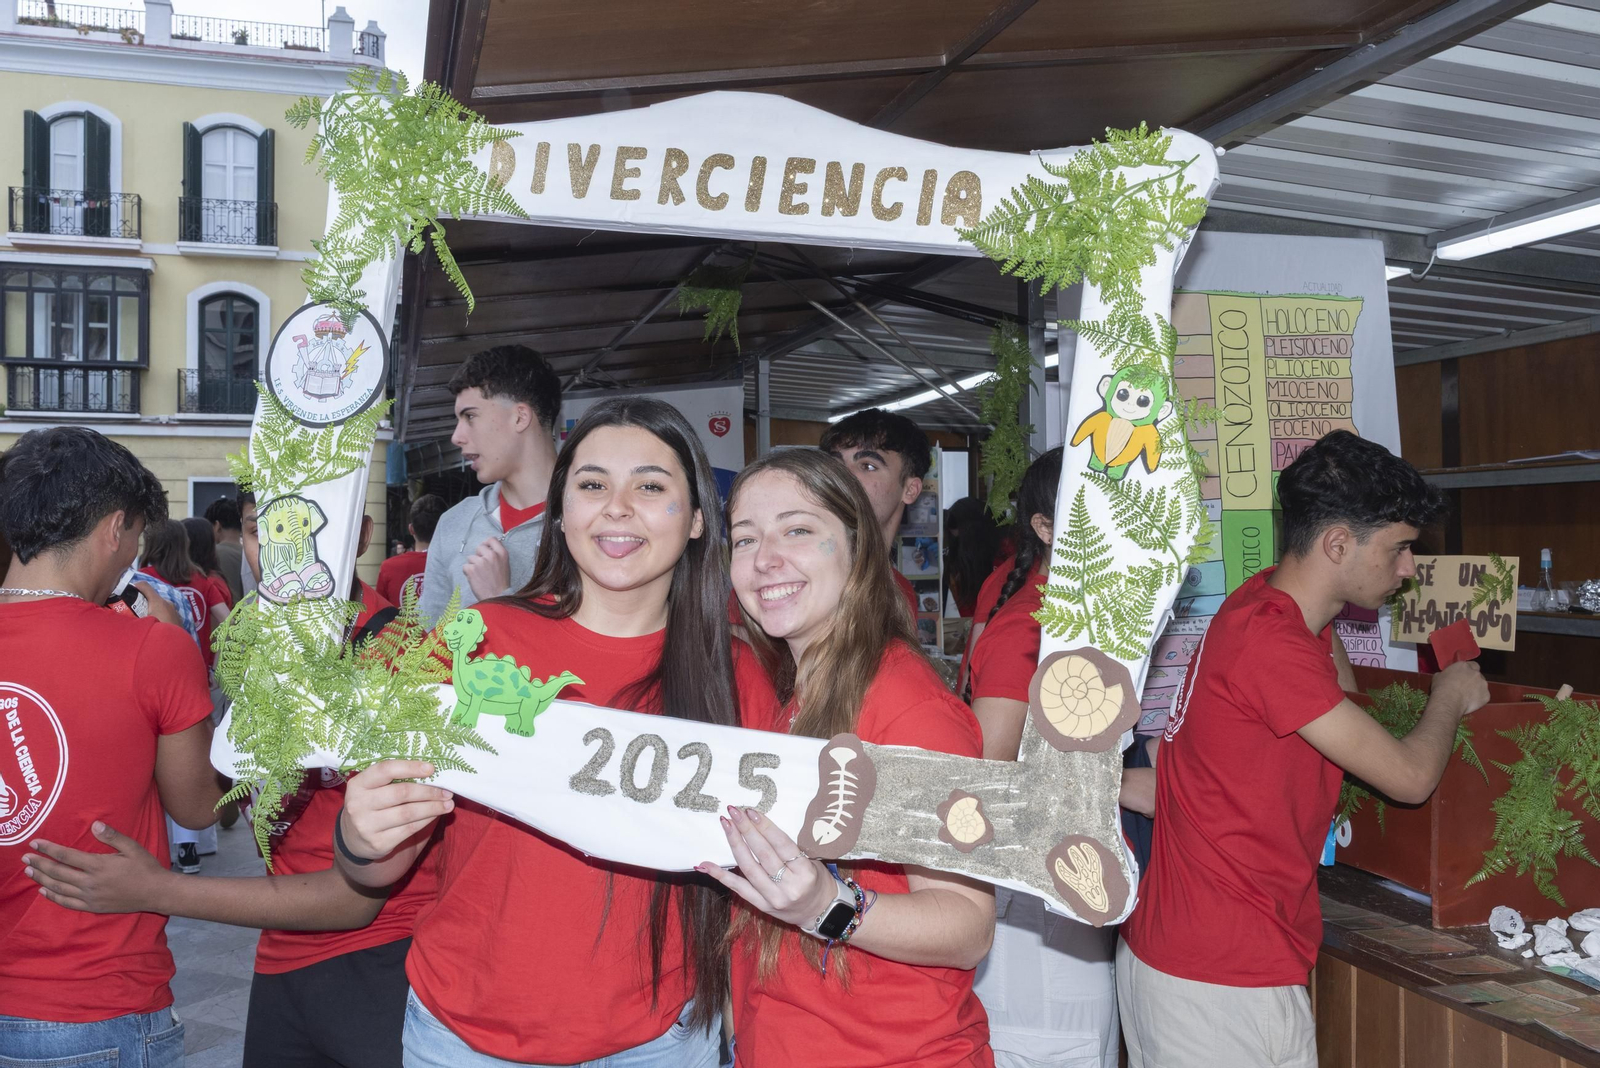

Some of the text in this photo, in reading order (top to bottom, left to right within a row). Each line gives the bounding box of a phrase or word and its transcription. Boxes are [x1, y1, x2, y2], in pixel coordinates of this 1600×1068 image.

[486, 138, 982, 227] DIVERCIENCIA
[1303, 281, 1343, 292] ACTUALIDAD
[1266, 307, 1350, 334] HOLOCENO
[1265, 337, 1348, 356] PLEISTOCENO
[1267, 359, 1339, 377] PLIOCENO
[1218, 309, 1257, 497] CENOZOICO
[1268, 380, 1339, 400] MIOCENO
[283, 395, 307, 418] VIRGEN
[307, 411, 318, 421] DE
[320, 413, 329, 421] LA
[331, 387, 373, 419] ESPERANZA
[1270, 402, 1347, 418] OLIGOCENO
[1274, 420, 1332, 437] EOCENO
[1416, 558, 1486, 587] SÉ UN
[5, 709, 43, 797] DE LA CIENCIA
[569, 727, 781, 814] 2025
